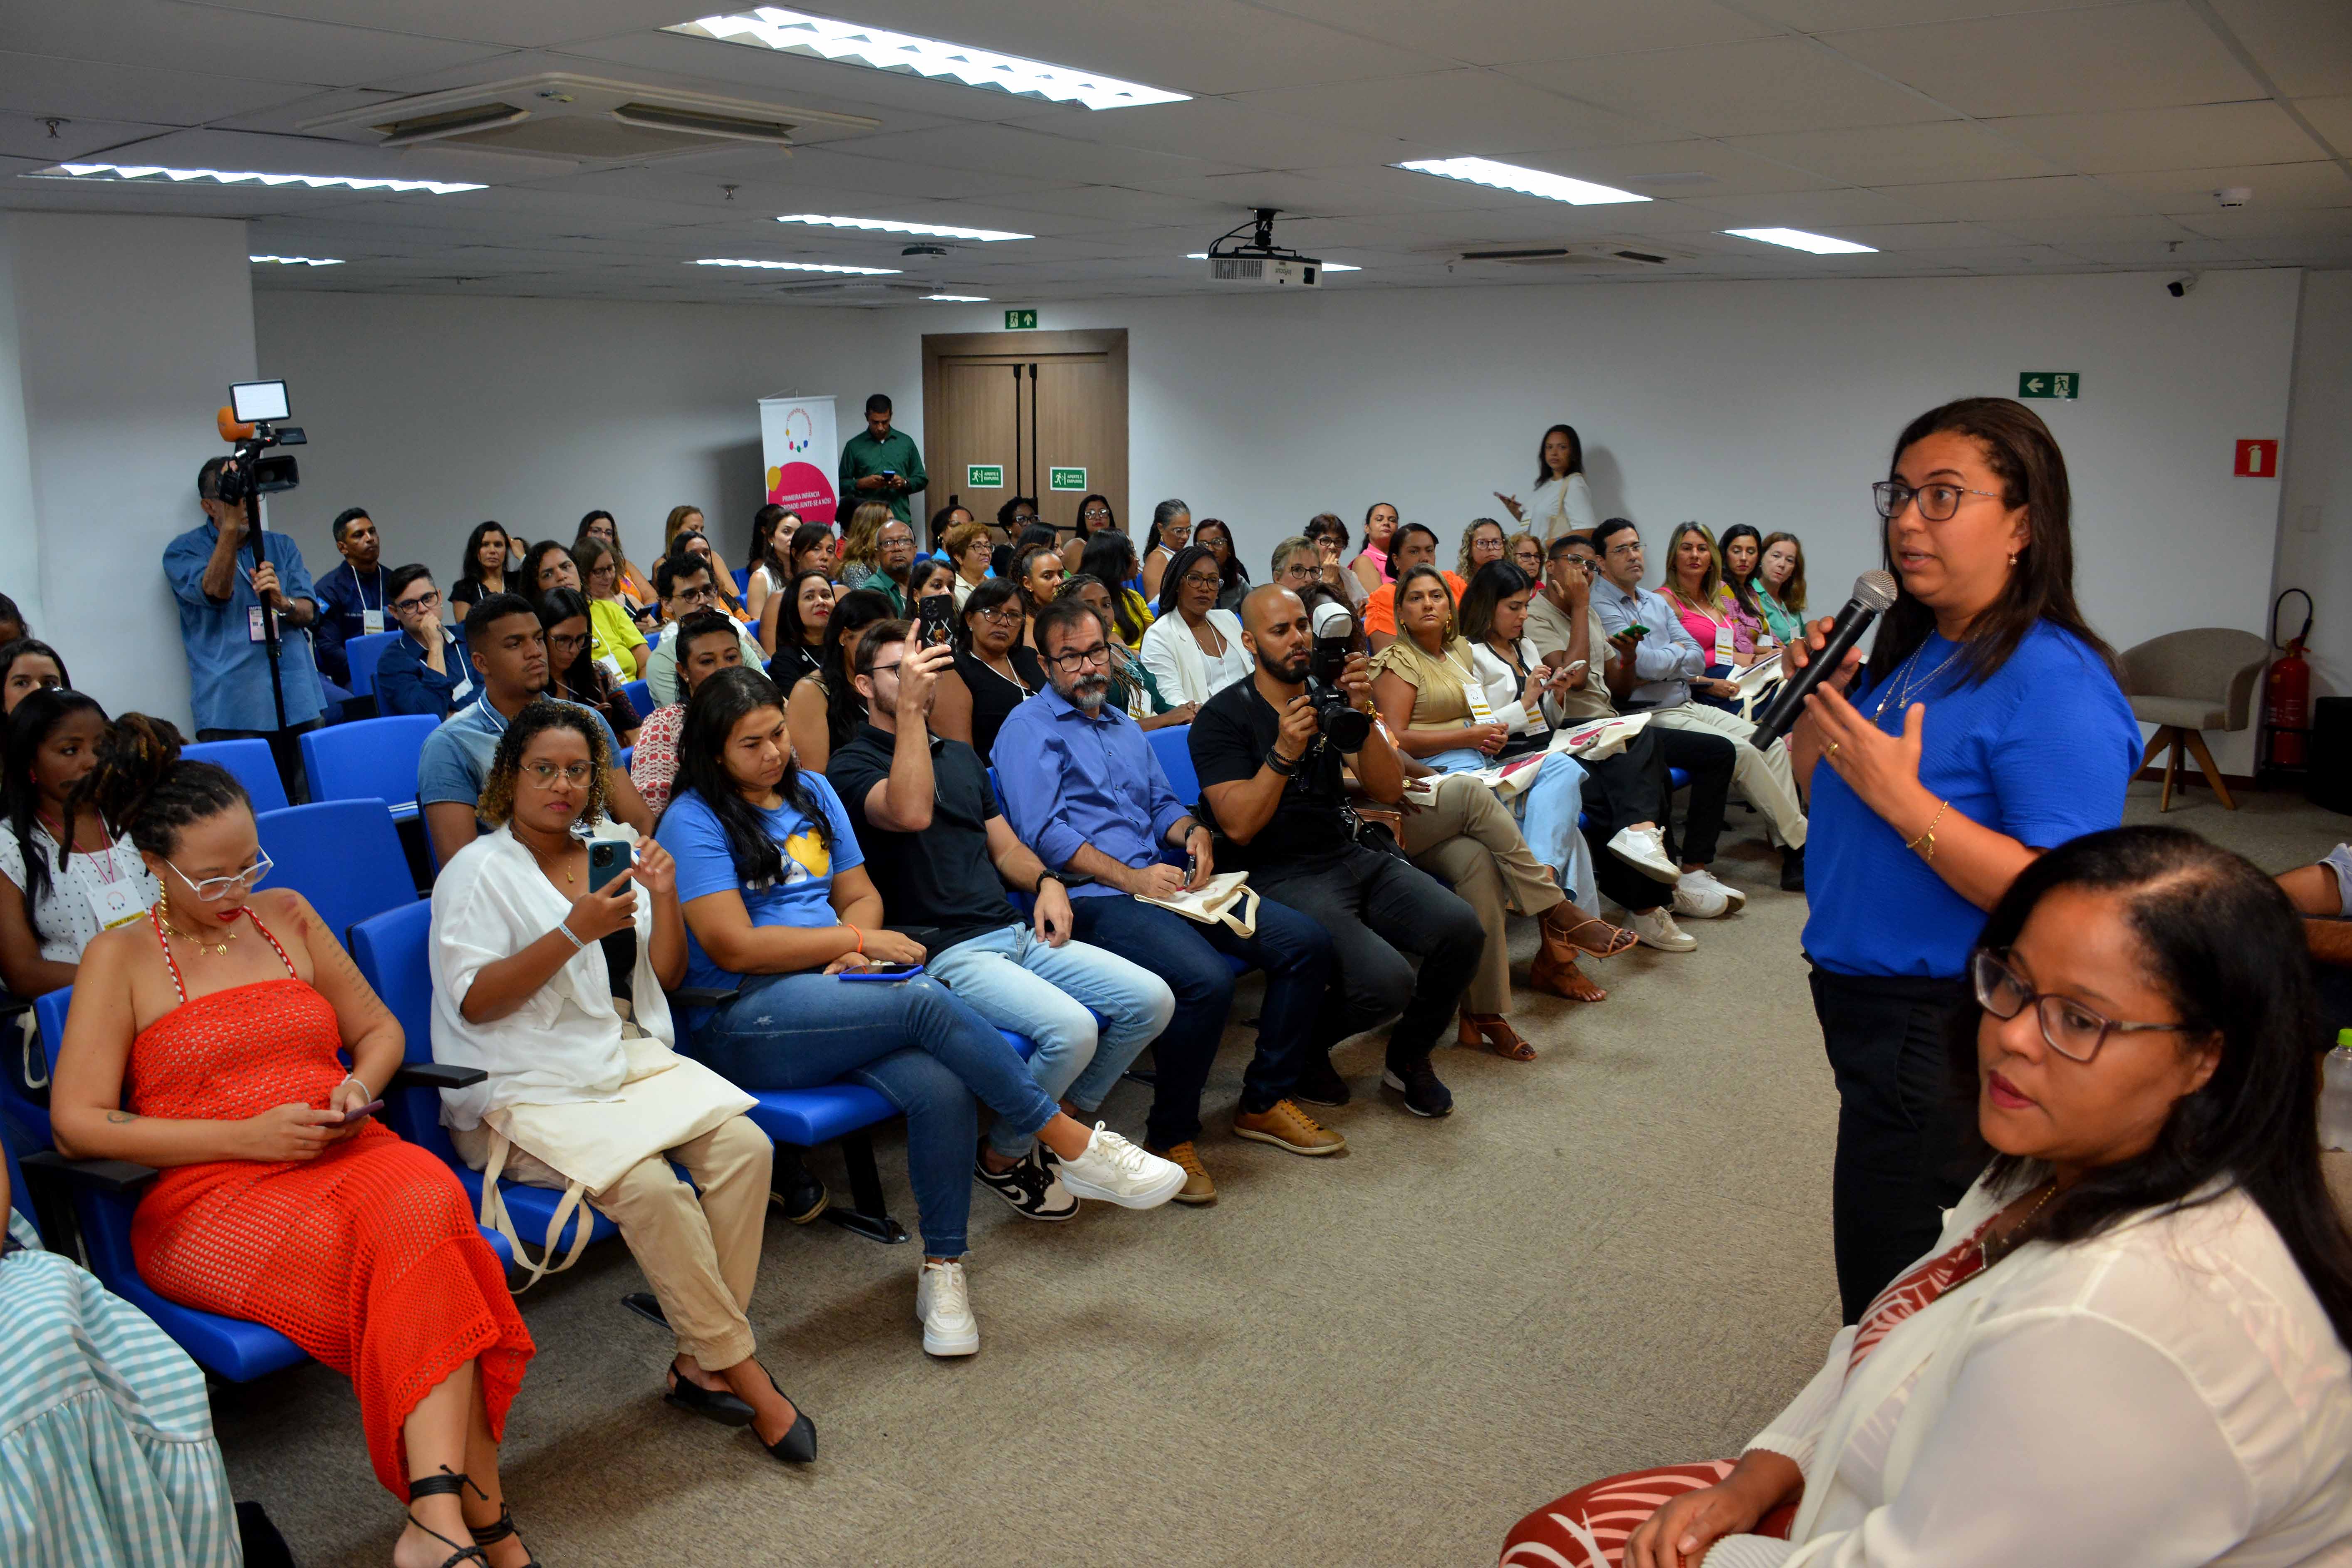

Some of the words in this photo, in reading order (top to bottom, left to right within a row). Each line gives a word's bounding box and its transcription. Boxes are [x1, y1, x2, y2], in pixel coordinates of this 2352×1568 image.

[782, 493, 801, 502] PRIMEIRA
[801, 490, 820, 500] INFÂNCIA
[800, 500, 818, 509] JUNTE-SE
